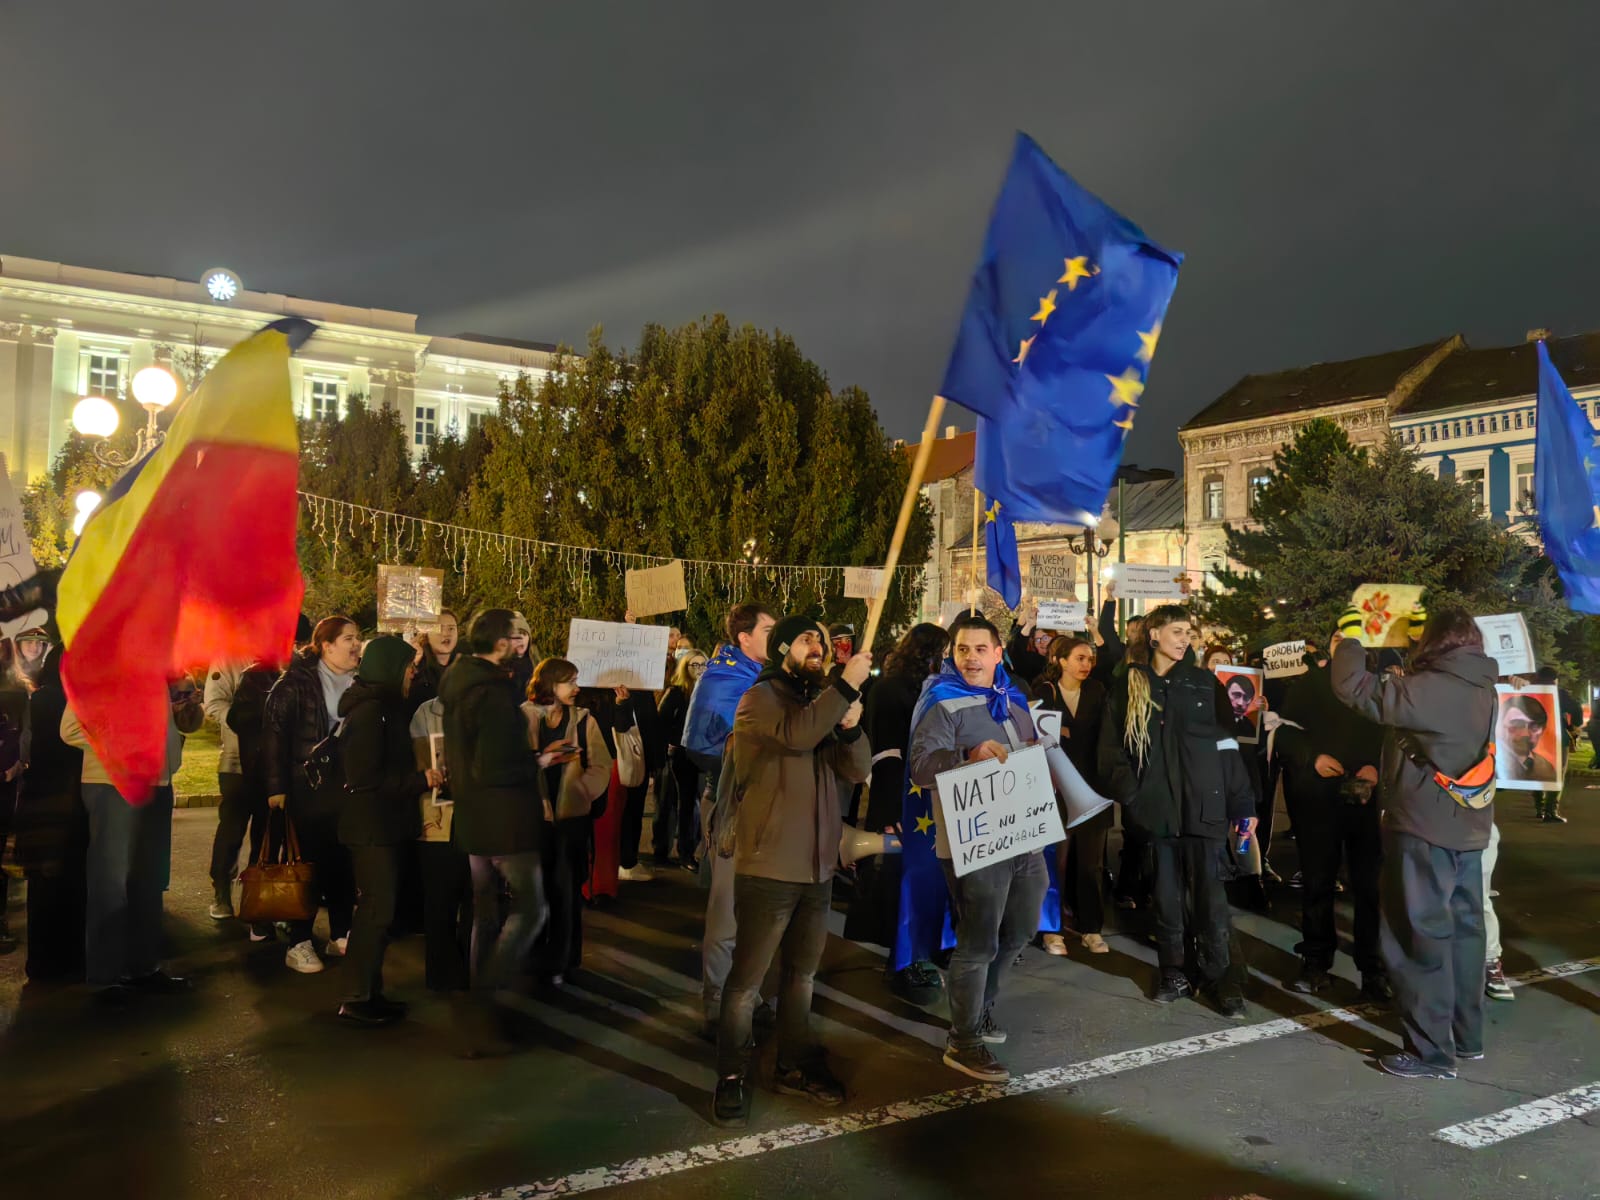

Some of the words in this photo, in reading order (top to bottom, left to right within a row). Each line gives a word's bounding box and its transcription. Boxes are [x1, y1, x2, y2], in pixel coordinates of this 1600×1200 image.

[1030, 554, 1040, 565] NU
[1042, 554, 1064, 566] VREM
[953, 770, 1016, 812] NATO
[957, 811, 990, 845] UE
[999, 814, 1016, 828] NU
[1025, 802, 1055, 818] SUNT
[962, 822, 1047, 866] NEGOCIABILE
